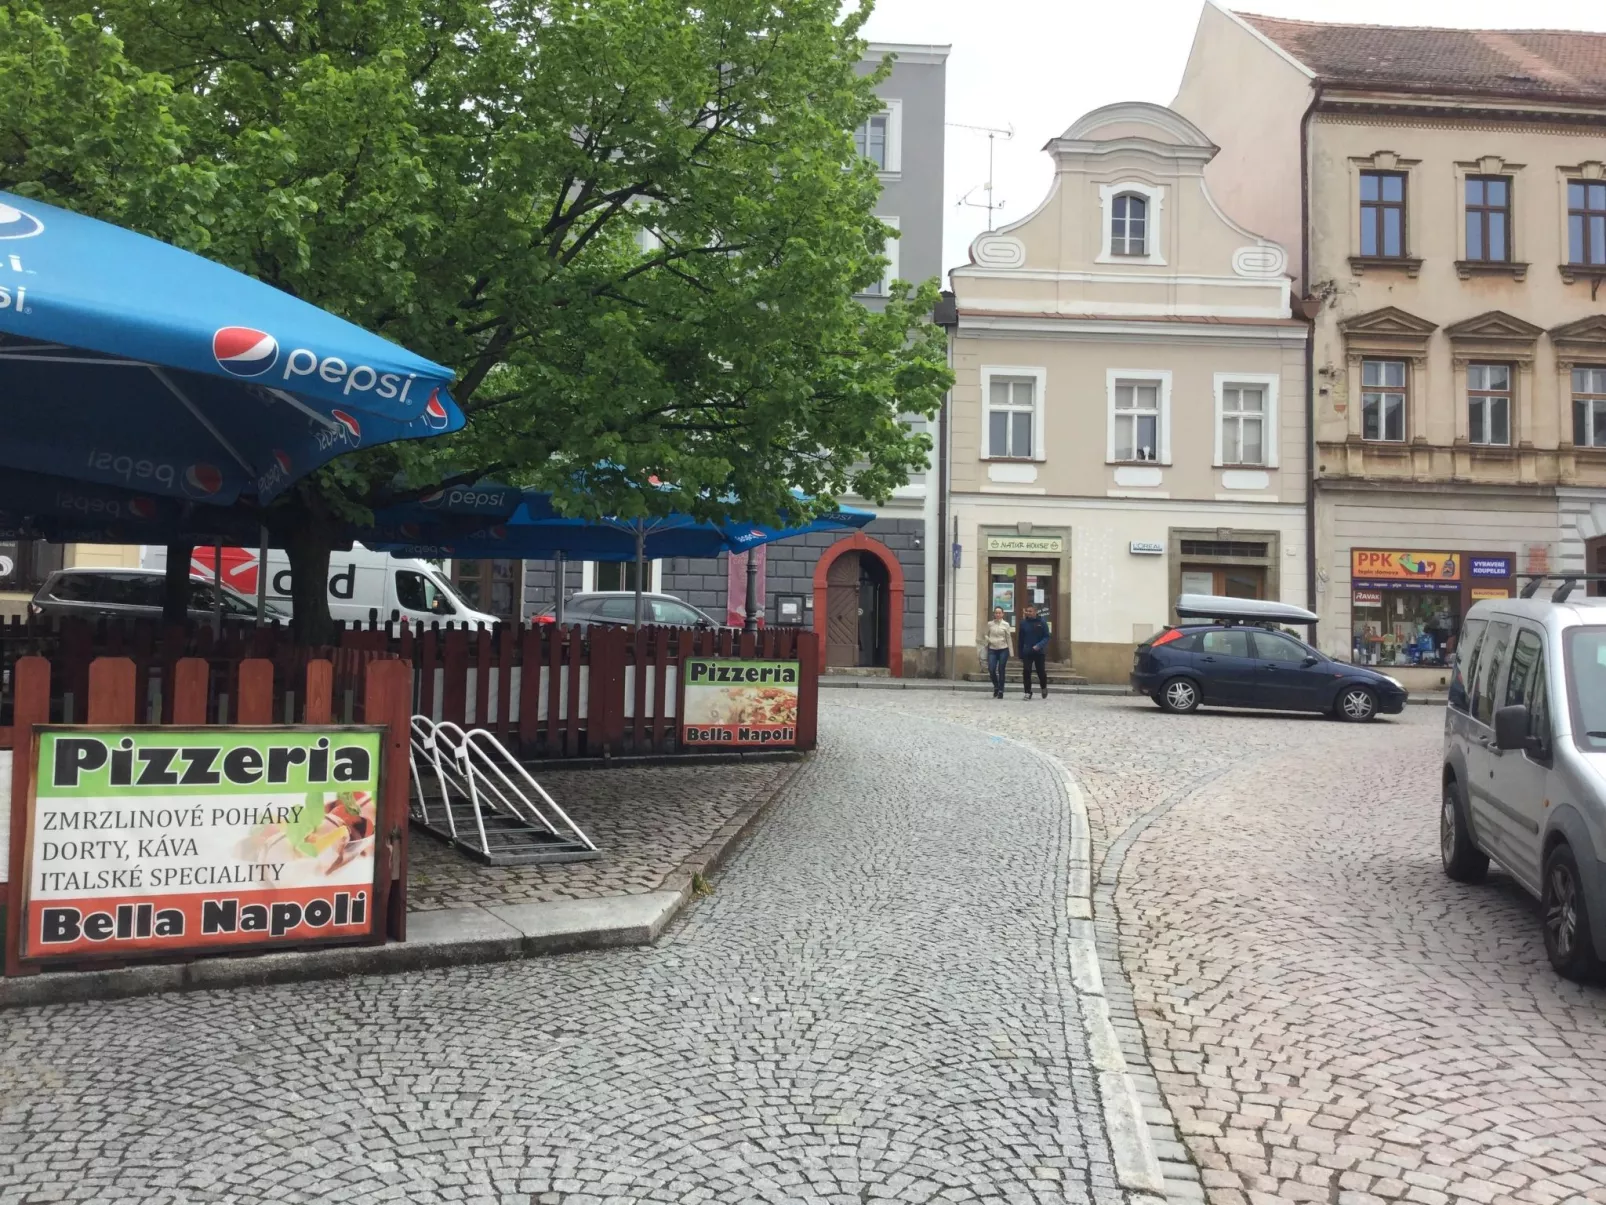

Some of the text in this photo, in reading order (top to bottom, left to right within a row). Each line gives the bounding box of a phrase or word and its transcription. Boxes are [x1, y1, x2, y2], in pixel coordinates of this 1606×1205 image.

[283, 348, 417, 403] pepsi
[448, 490, 506, 508] pepsi
[1000, 541, 1025, 549] NATUR
[1358, 553, 1393, 567] PPK
[1356, 592, 1380, 600] RAVAK
[690, 662, 795, 682] Pizzeria
[687, 727, 794, 743] Bella Napoli
[53, 737, 371, 787] Pizzeria
[43, 802, 303, 831] ZMRZLINOVÉ POHÁRY
[42, 835, 199, 861] DORTY, KÁVA
[40, 863, 285, 891] ITALSKÉ SPECIALITY
[41, 891, 367, 944] Bella Napoli
